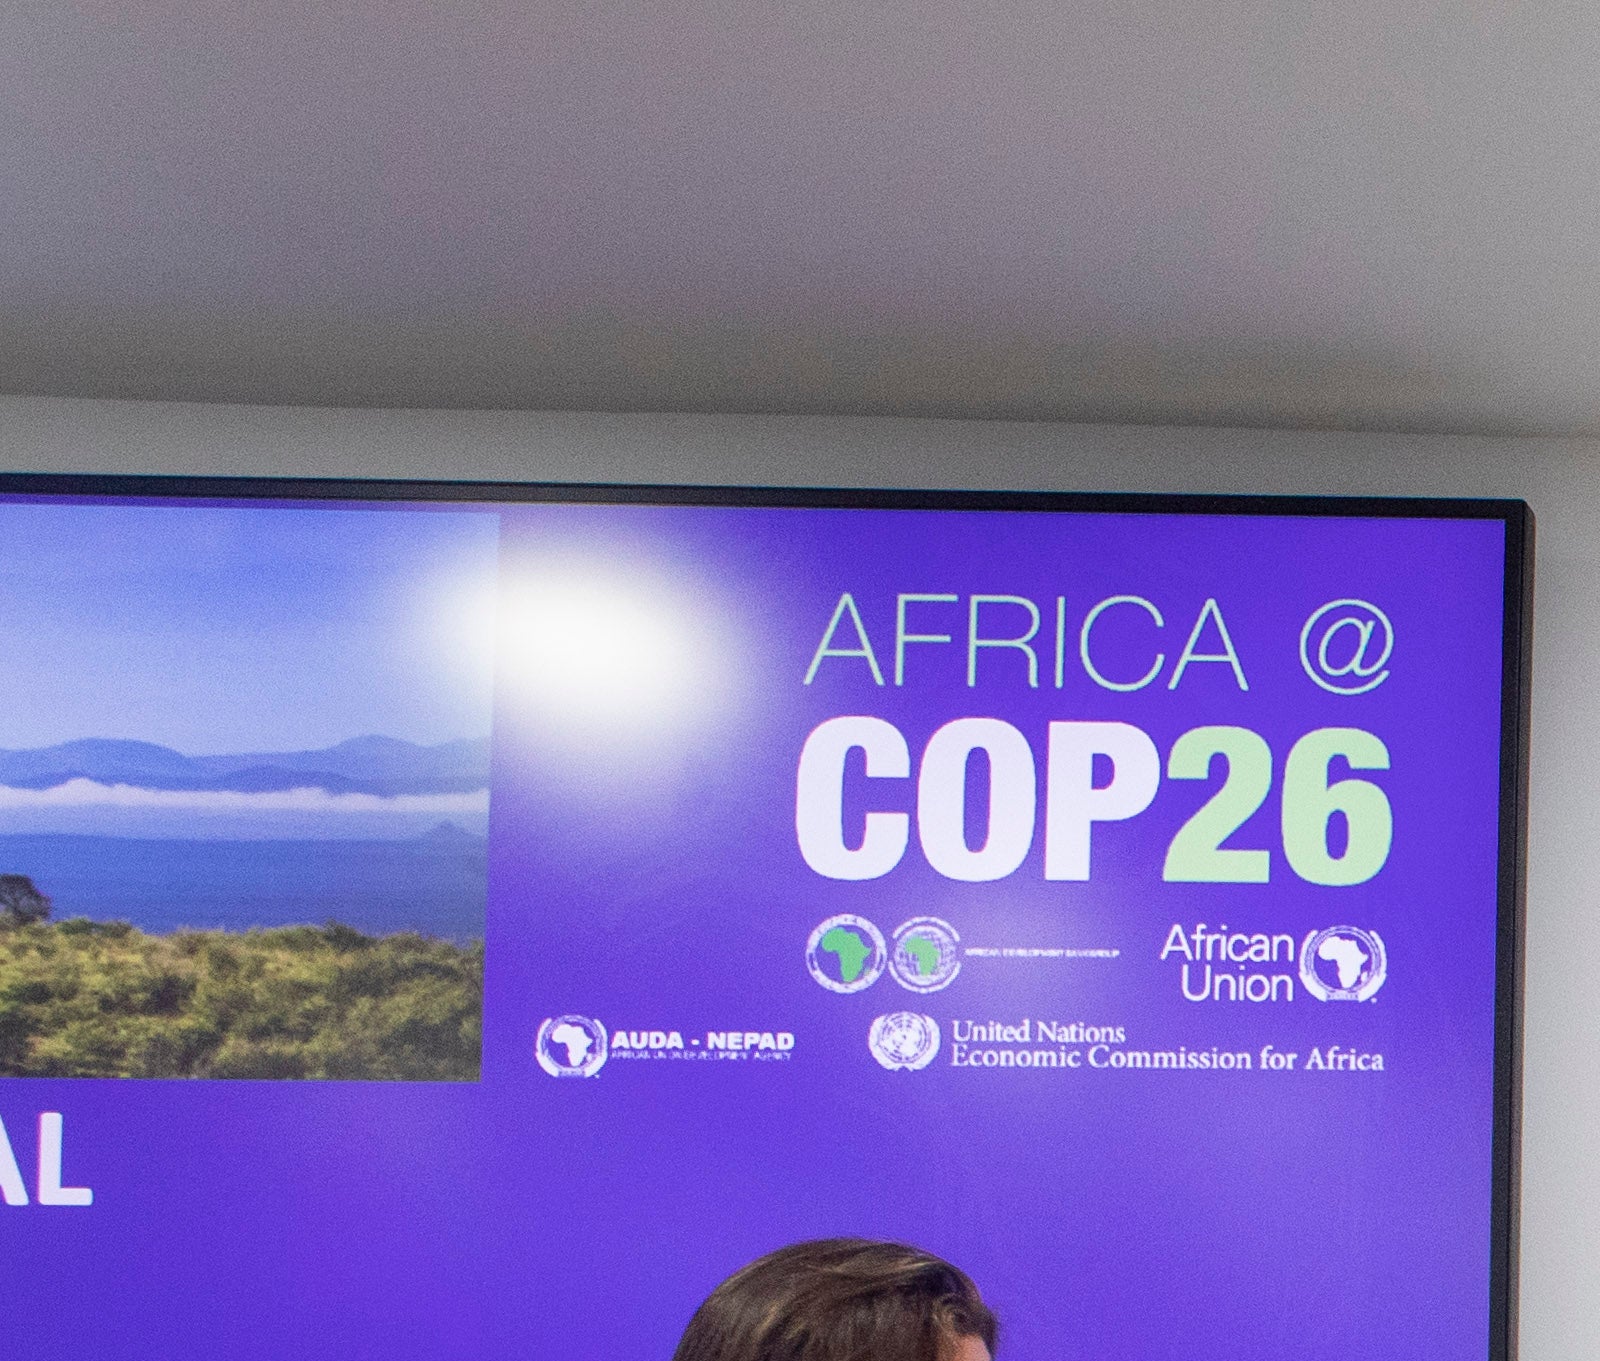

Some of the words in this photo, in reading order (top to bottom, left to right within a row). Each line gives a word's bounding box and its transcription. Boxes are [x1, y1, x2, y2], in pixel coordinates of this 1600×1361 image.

[804, 593, 1249, 691] AFRICA
[1300, 599, 1394, 695] @
[796, 715, 1394, 886] COP26
[1160, 924, 1295, 962] African
[1181, 964, 1294, 1002] Union
[611, 1031, 684, 1050] AUDA
[707, 1031, 795, 1051] NEPAD
[952, 1020, 1030, 1043] United
[1037, 1021, 1126, 1044] Nations
[951, 1045, 1081, 1068] Economic
[1088, 1045, 1252, 1070] Commission
[1259, 1045, 1297, 1070] for
[1305, 1047, 1385, 1072] Africa
